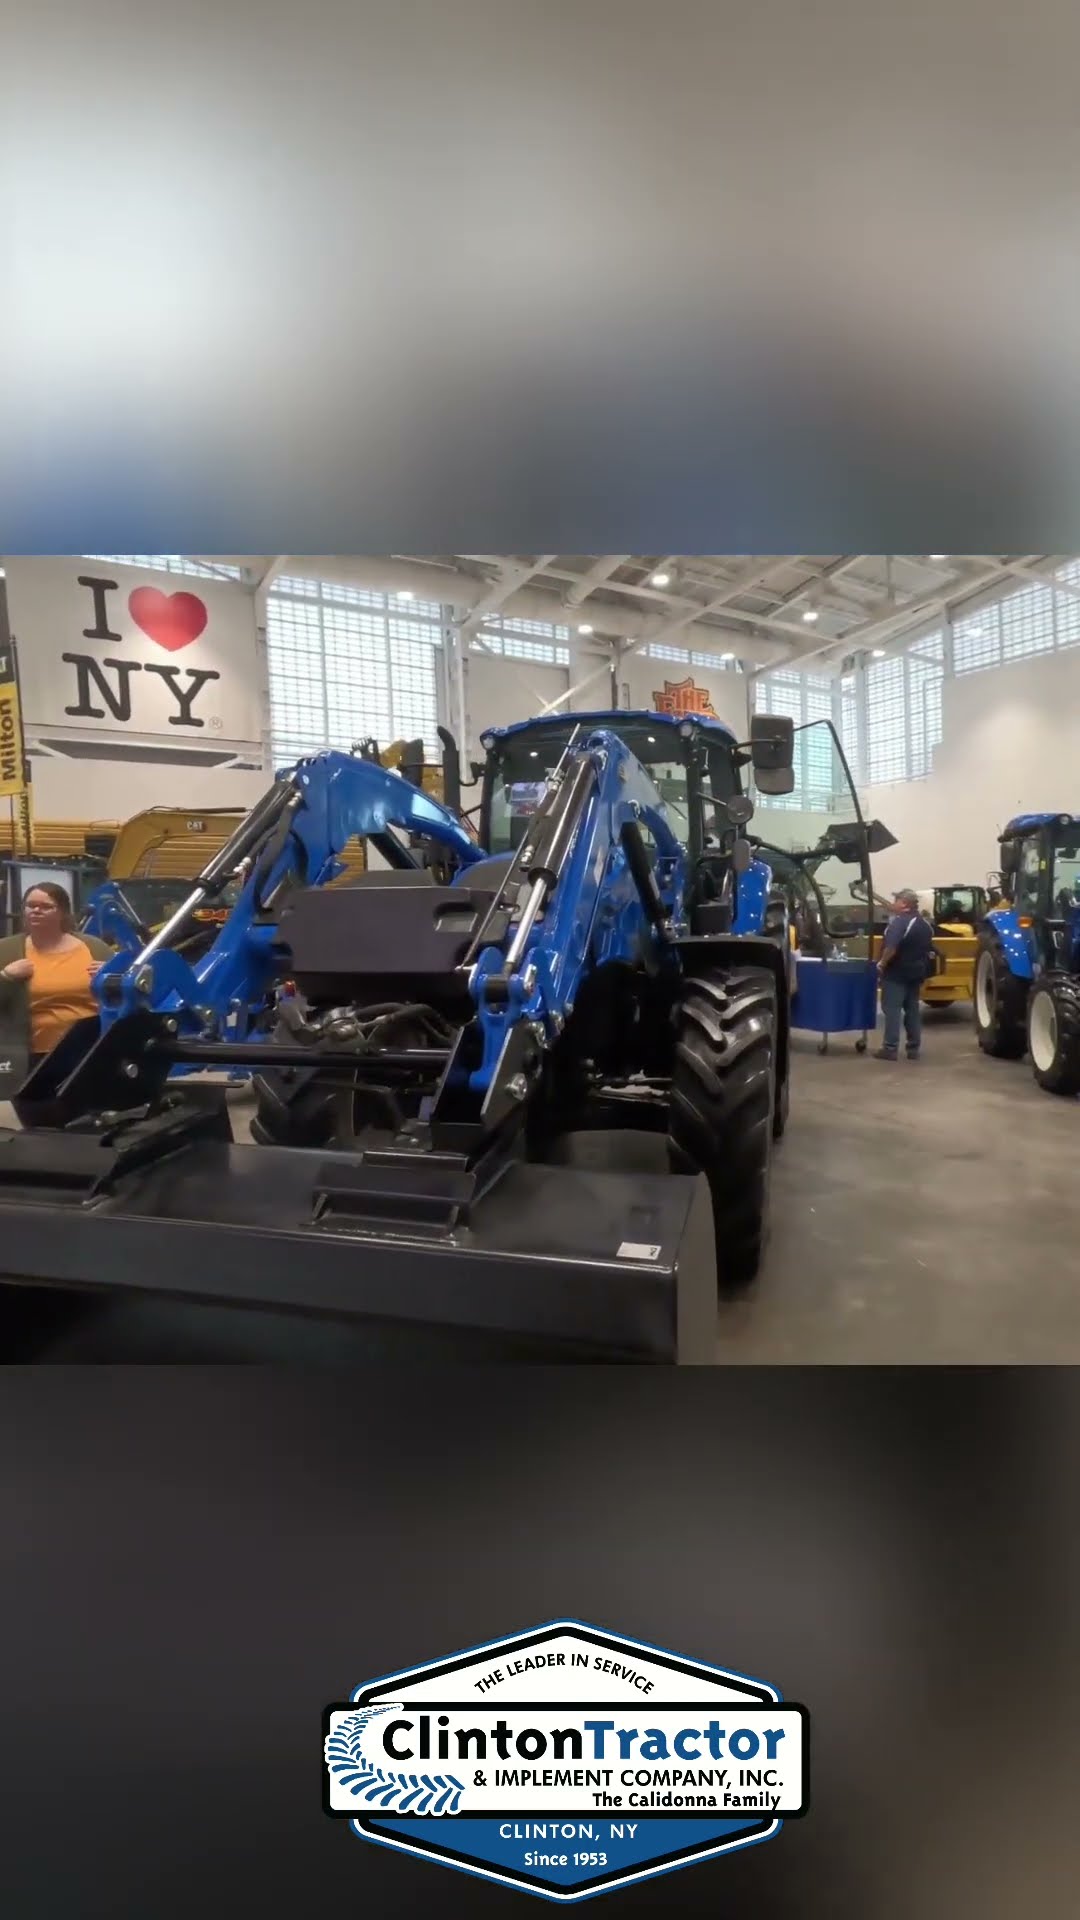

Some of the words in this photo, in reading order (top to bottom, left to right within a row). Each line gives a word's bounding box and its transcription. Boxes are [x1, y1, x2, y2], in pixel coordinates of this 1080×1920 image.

[78, 576, 122, 642] I
[62, 652, 220, 728] NY
[0, 699, 16, 781] Milton
[186, 820, 204, 831] CAT
